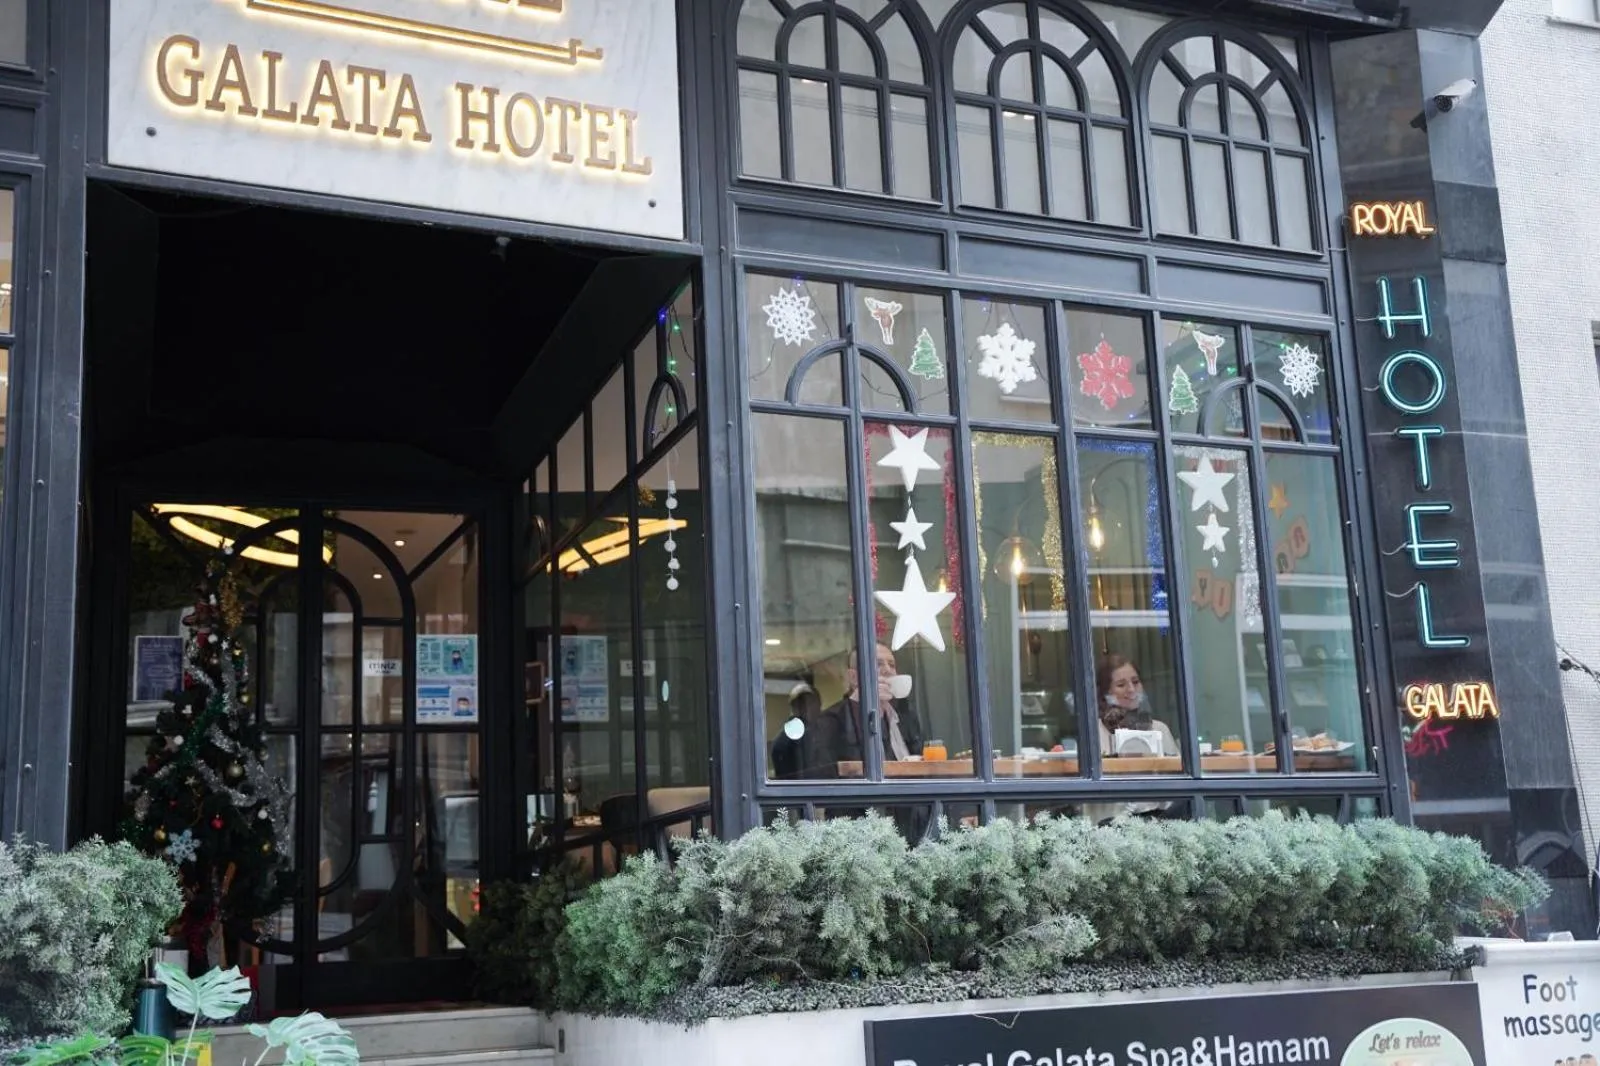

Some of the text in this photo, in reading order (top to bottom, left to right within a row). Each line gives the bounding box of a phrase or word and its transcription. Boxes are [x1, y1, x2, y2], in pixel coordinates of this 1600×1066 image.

[156, 34, 653, 176] GALATA HOTEL
[1352, 201, 1436, 236] ROYAL
[1376, 275, 1470, 648] HOTEL
[1404, 682, 1500, 719] GALATA
[1523, 974, 1577, 1004] Foot
[1126, 1035, 1331, 1066] Spa&Hamam
[1368, 1030, 1441, 1054] Let's relax
